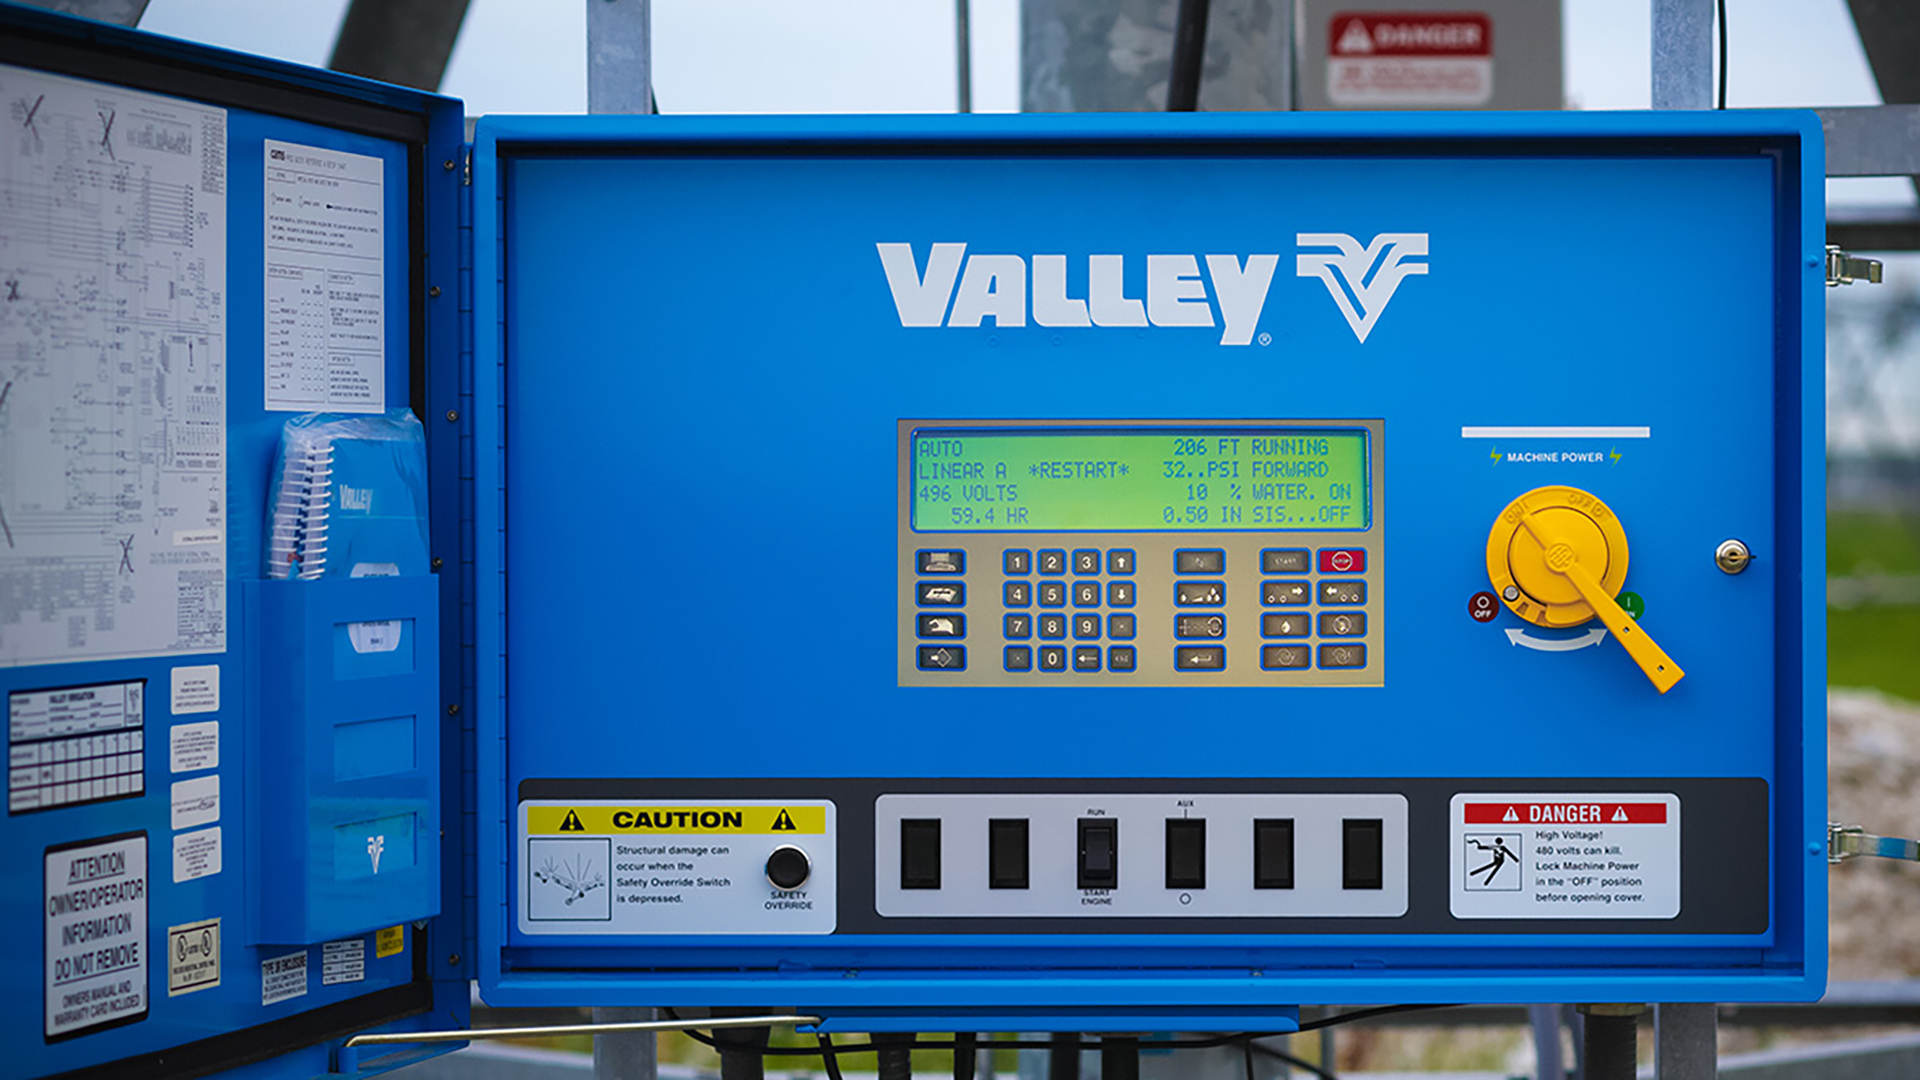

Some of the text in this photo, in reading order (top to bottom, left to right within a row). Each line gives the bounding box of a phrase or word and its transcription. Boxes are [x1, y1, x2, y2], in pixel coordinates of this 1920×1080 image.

[1373, 22, 1483, 49] DANGER
[876, 242, 1280, 345] VALLEY
[919, 438, 1329, 457] AUTO 206 FT RUNNING
[1507, 452, 1604, 463] MACHINE POWER
[919, 462, 985, 480] LINEAR
[995, 462, 1007, 479] A
[1252, 460, 1329, 478] FORWARD
[918, 483, 1351, 502] 496 VOLTS 10 % WATER. ON
[951, 507, 995, 525] 59.4
[1006, 507, 1029, 524] HR
[1162, 505, 1208, 523] 0.50
[1221, 505, 1242, 523] IN
[1014, 556, 1021, 569] 1
[1048, 556, 1057, 569] 2
[1082, 556, 1092, 569] 3
[1013, 588, 1022, 601] 4
[1048, 588, 1057, 601] 5
[1082, 588, 1092, 601] 6
[1474, 609, 1492, 619] OFF
[1013, 620, 1023, 633] 7
[1048, 620, 1057, 633] 8
[1082, 620, 1092, 633] 9
[1048, 652, 1058, 665] 0
[612, 811, 743, 828] CAUTION
[1530, 805, 1602, 822] DANGER
[1535, 831, 1604, 841] High Voltage!
[616, 845, 730, 858] Structural damage can
[1535, 846, 1623, 856] 480 volts can kill.
[68, 851, 125, 879] ATTENTION
[616, 861, 694, 872] occur when the
[1535, 862, 1639, 871] Lock Machine Power
[616, 877, 731, 889] Safety Override Switch
[1535, 877, 1546, 886] in
[1547, 877, 1564, 886] the
[1601, 877, 1642, 888] position
[48, 878, 144, 917] OWNER/OPERATOR
[616, 893, 684, 905] is depressed.
[769, 891, 808, 900] SAFETY
[1535, 892, 1645, 904] before opening cover.
[764, 901, 813, 910] OVERRIDE
[62, 912, 132, 947] INFORMATION
[54, 942, 139, 981] DO NOT REMOVE
[62, 989, 90, 1009] OWNERS
[118, 980, 132, 995] AND
